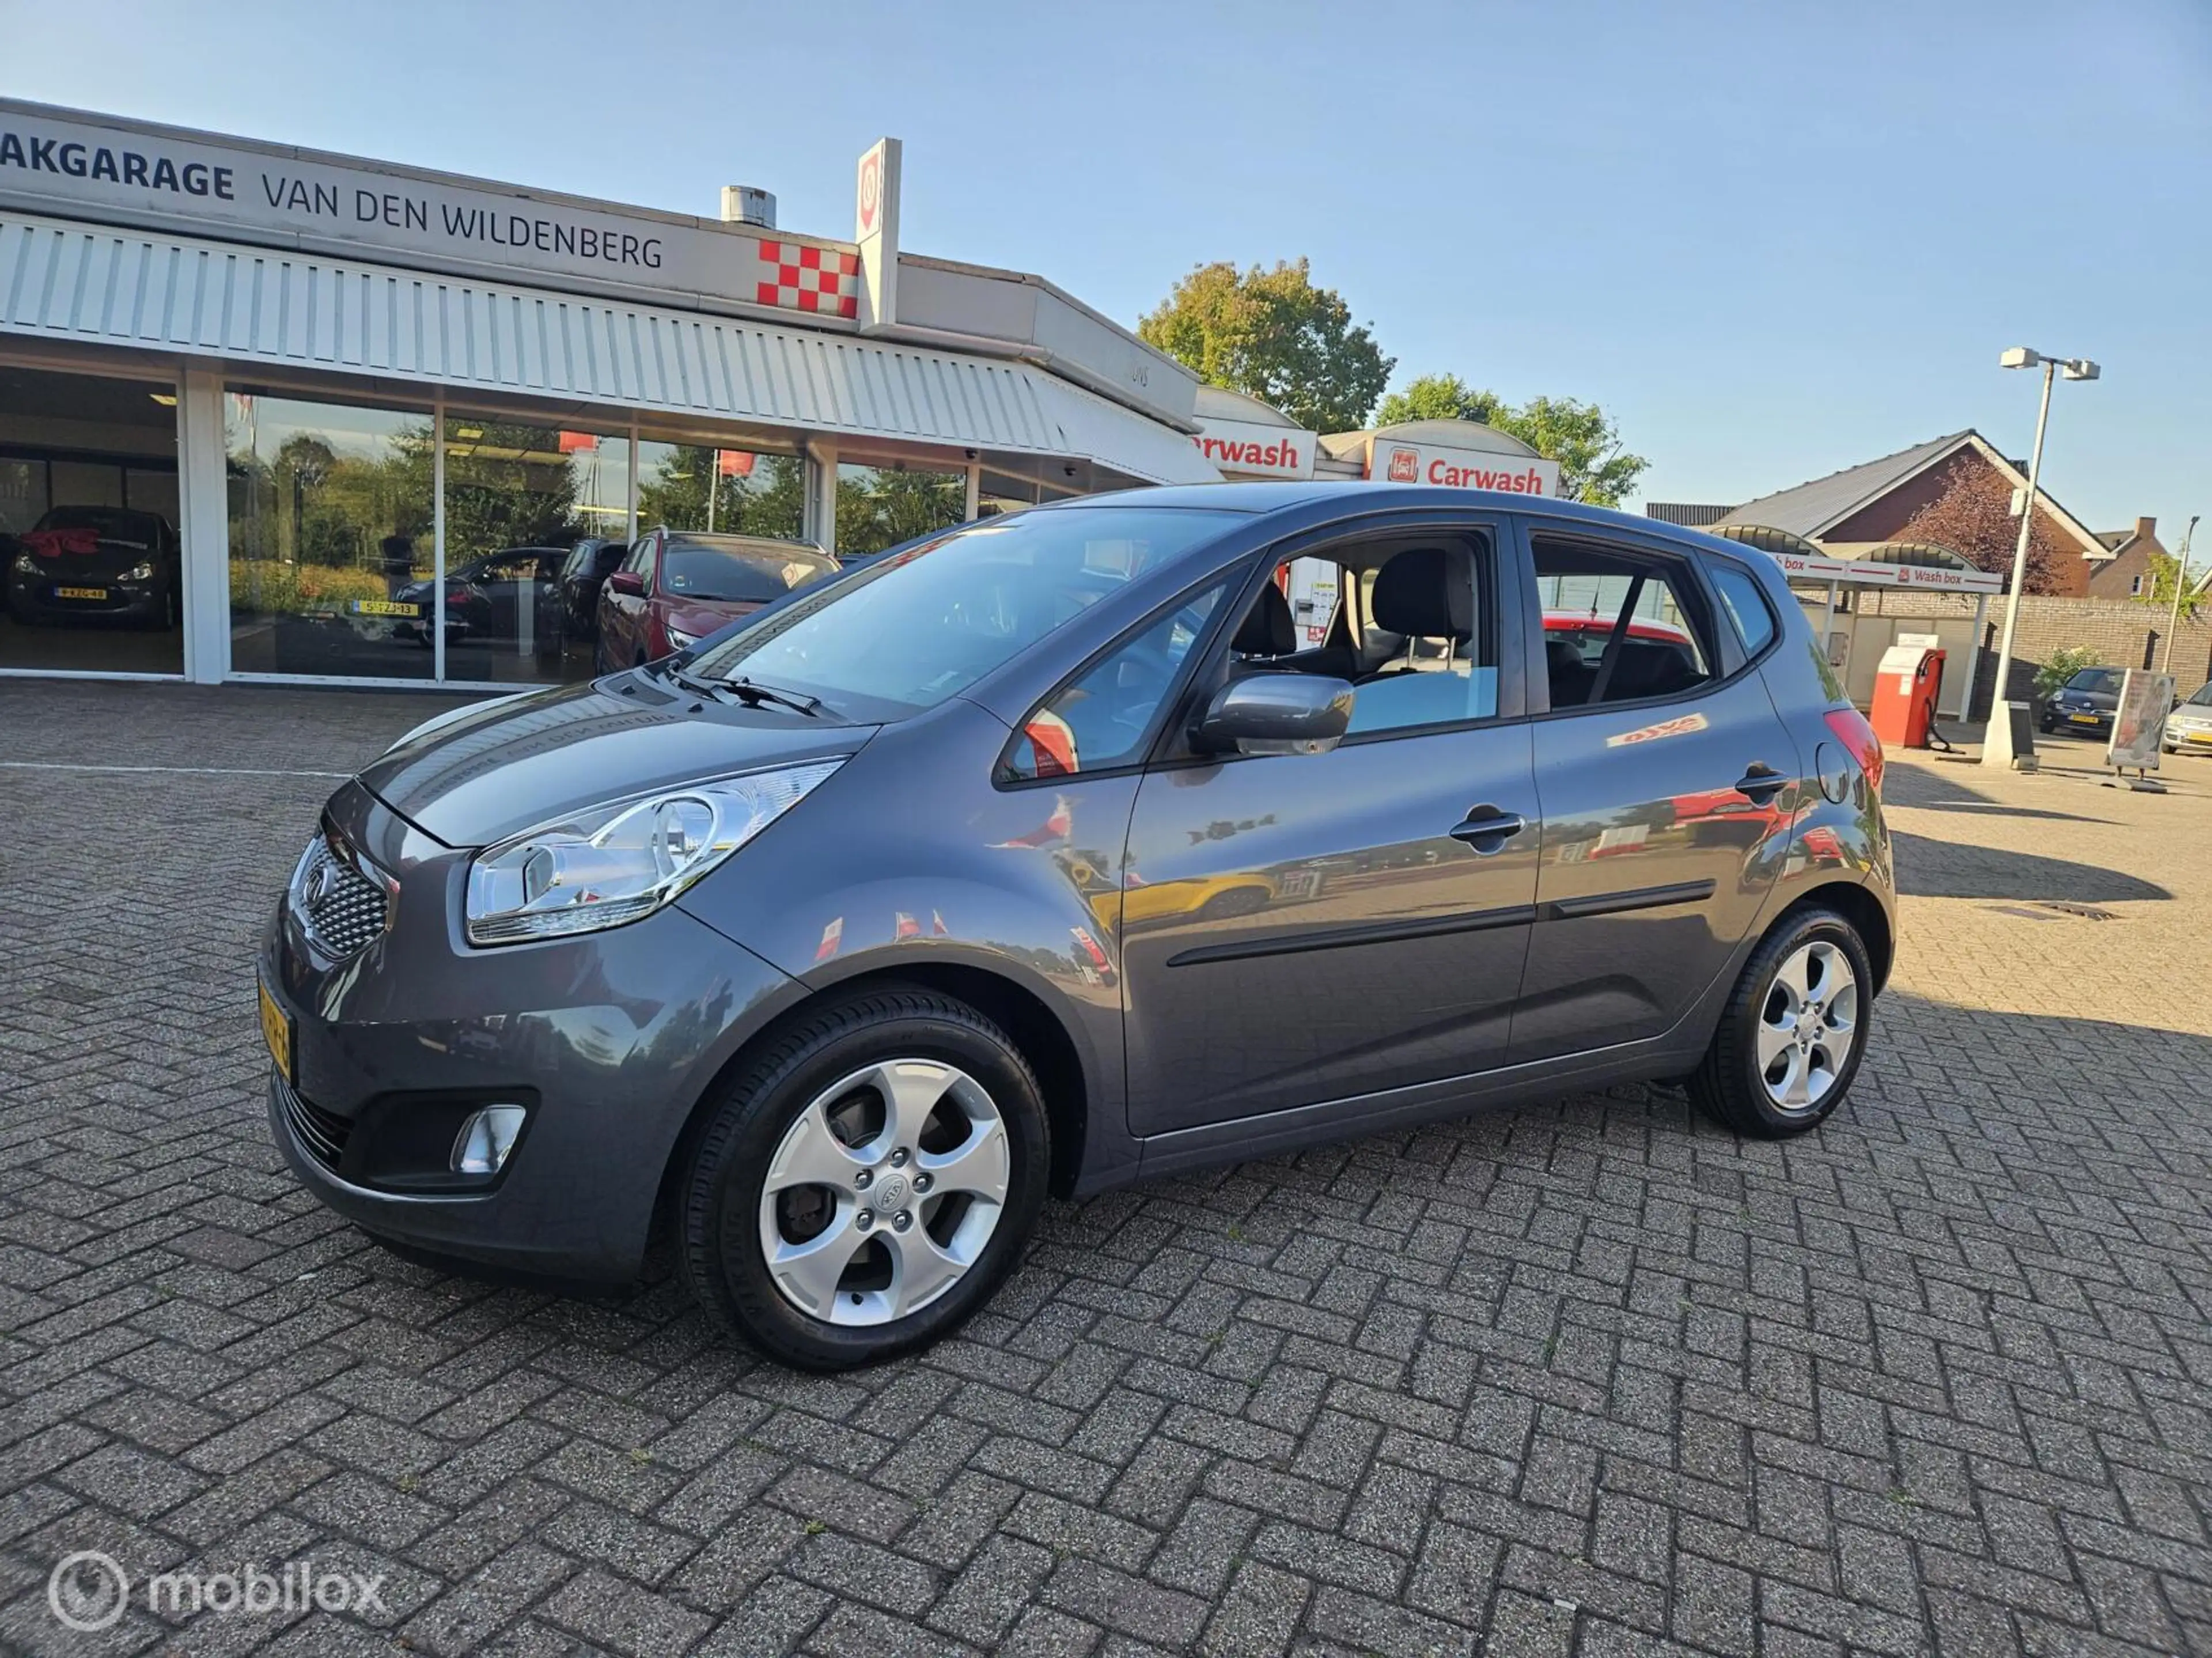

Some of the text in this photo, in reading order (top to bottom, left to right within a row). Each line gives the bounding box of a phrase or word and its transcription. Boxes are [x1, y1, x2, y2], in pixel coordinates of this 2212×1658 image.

[262, 173, 338, 217] VAN
[355, 189, 428, 231] DEN
[442, 204, 662, 269] WILDENBERG
[1428, 460, 1543, 494] Carwash
[1915, 570, 1962, 586] Wash box
